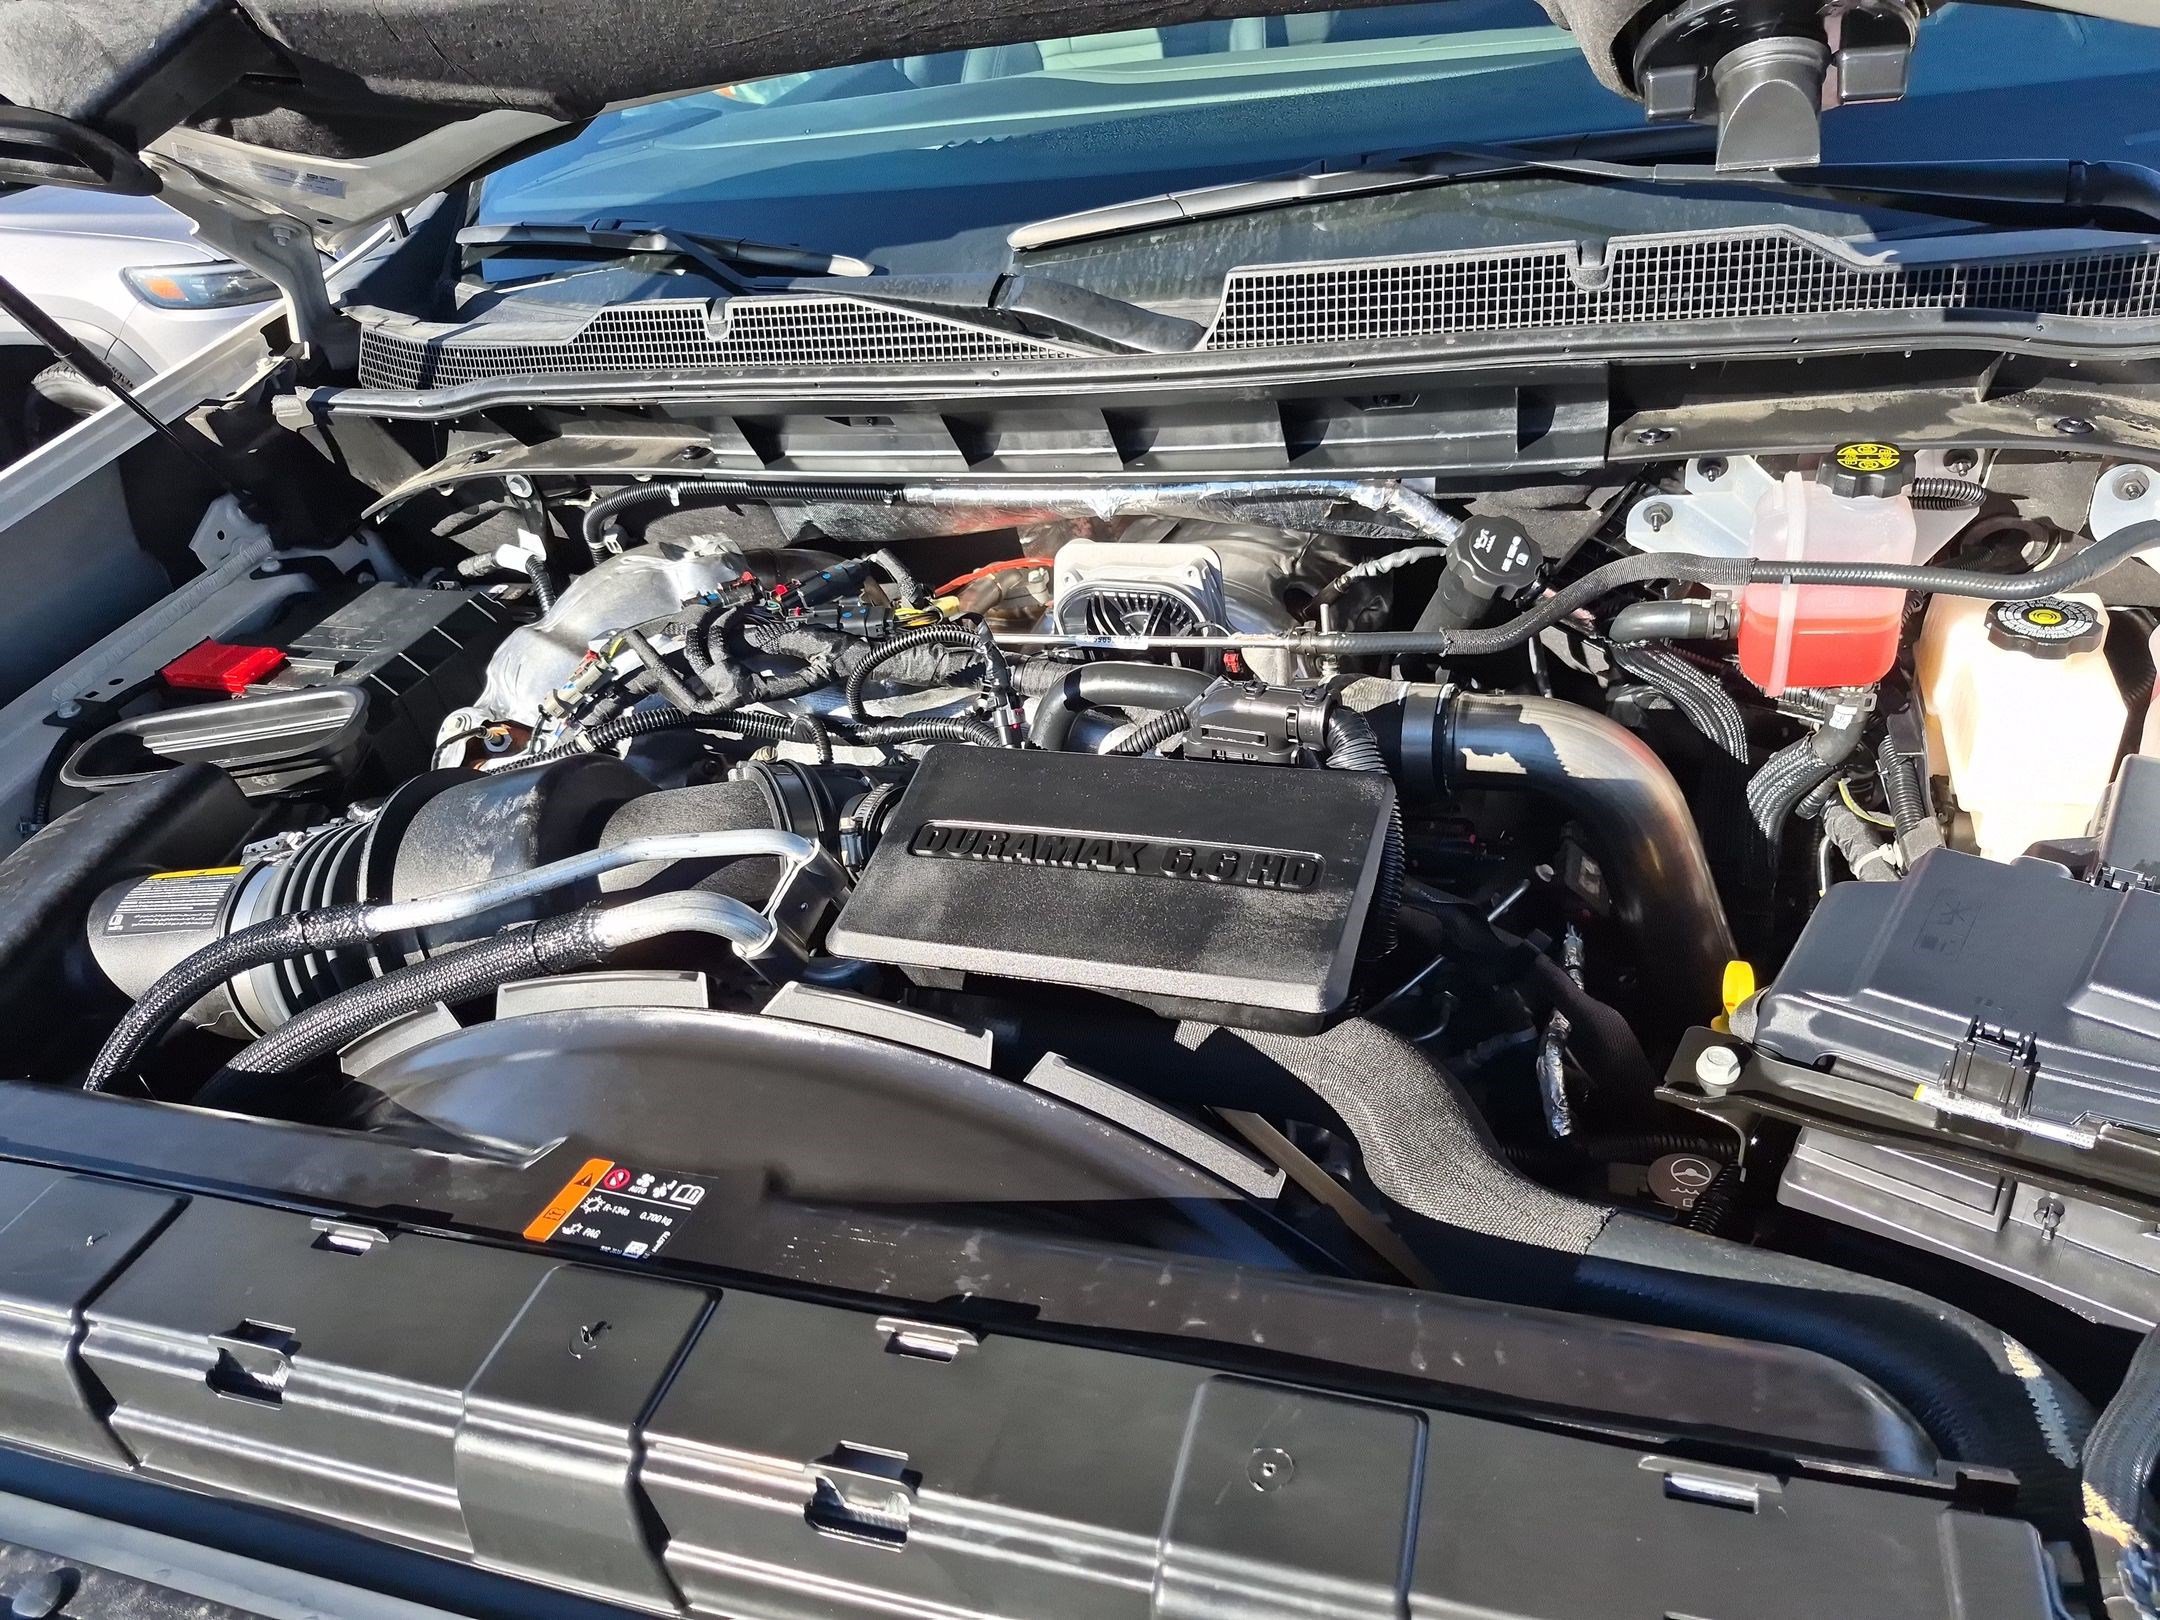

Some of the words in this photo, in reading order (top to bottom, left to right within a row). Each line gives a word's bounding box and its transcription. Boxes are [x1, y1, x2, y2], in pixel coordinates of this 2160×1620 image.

[913, 827, 1150, 873] DURAMAX
[1161, 846, 1242, 882] 6.6
[1245, 853, 1322, 888] HD
[628, 1185, 648, 1195] AUTO
[582, 1228, 601, 1239] PAG
